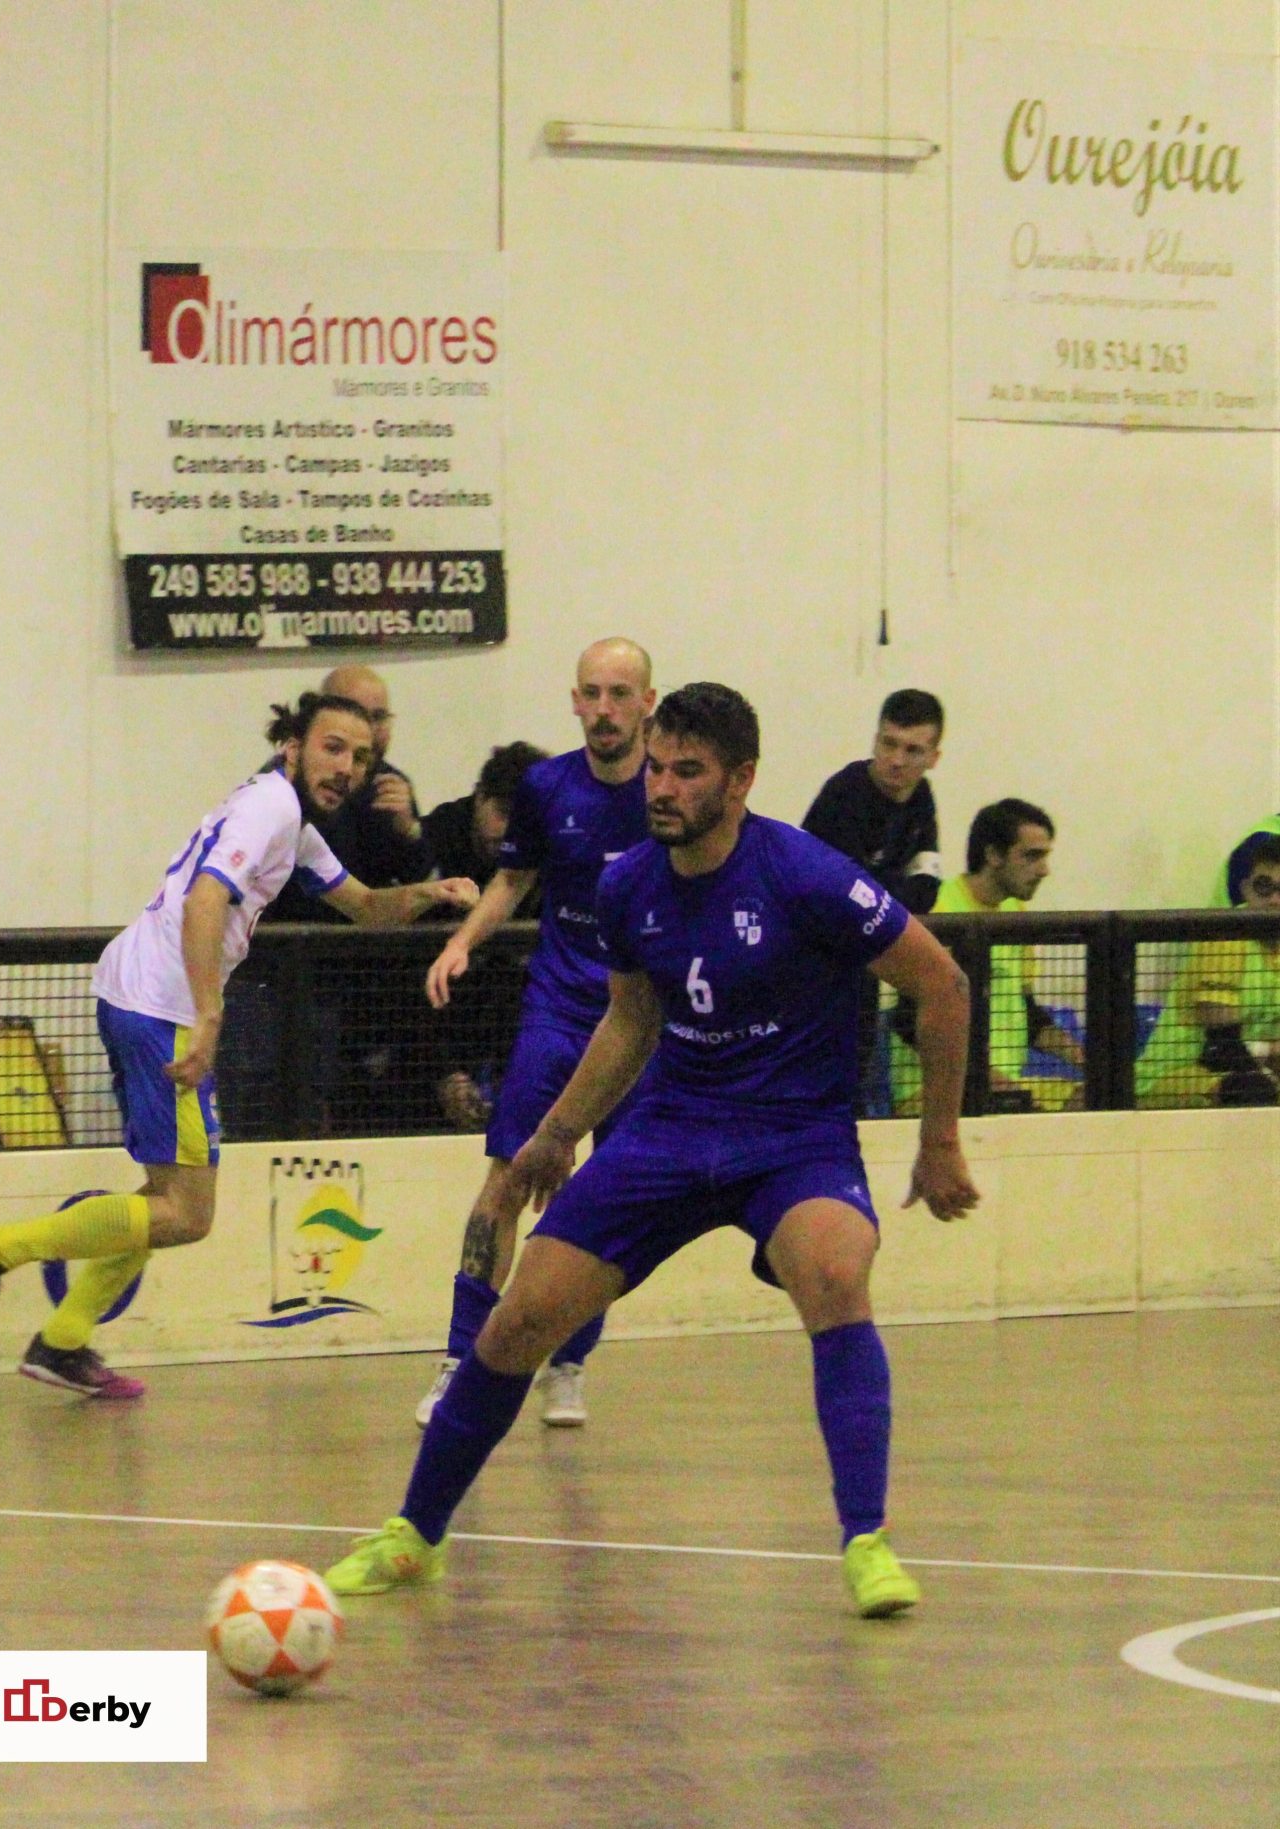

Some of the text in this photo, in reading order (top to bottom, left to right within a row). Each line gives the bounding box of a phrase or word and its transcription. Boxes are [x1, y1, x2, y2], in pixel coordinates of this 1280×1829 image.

[1002, 98, 1244, 217] Ourejóia
[373, 419, 455, 438] Granitos
[173, 454, 267, 474] Cantarias
[285, 454, 362, 477] Campas
[380, 454, 451, 477] Jazigos
[208, 490, 231, 509] de
[238, 489, 281, 509] Sala
[298, 489, 372, 511] Tampos
[378, 488, 402, 508] de
[407, 488, 492, 508] Cozinhas
[240, 524, 395, 543] Casas de Banho
[148, 563, 199, 598] 249
[206, 563, 255, 597] 585
[260, 562, 310, 597] 988
[332, 561, 381, 595] 938
[387, 561, 434, 594] 444
[439, 560, 487, 594] 253
[168, 608, 473, 638] www.omarmores.com
[686, 957, 714, 1013] 6
